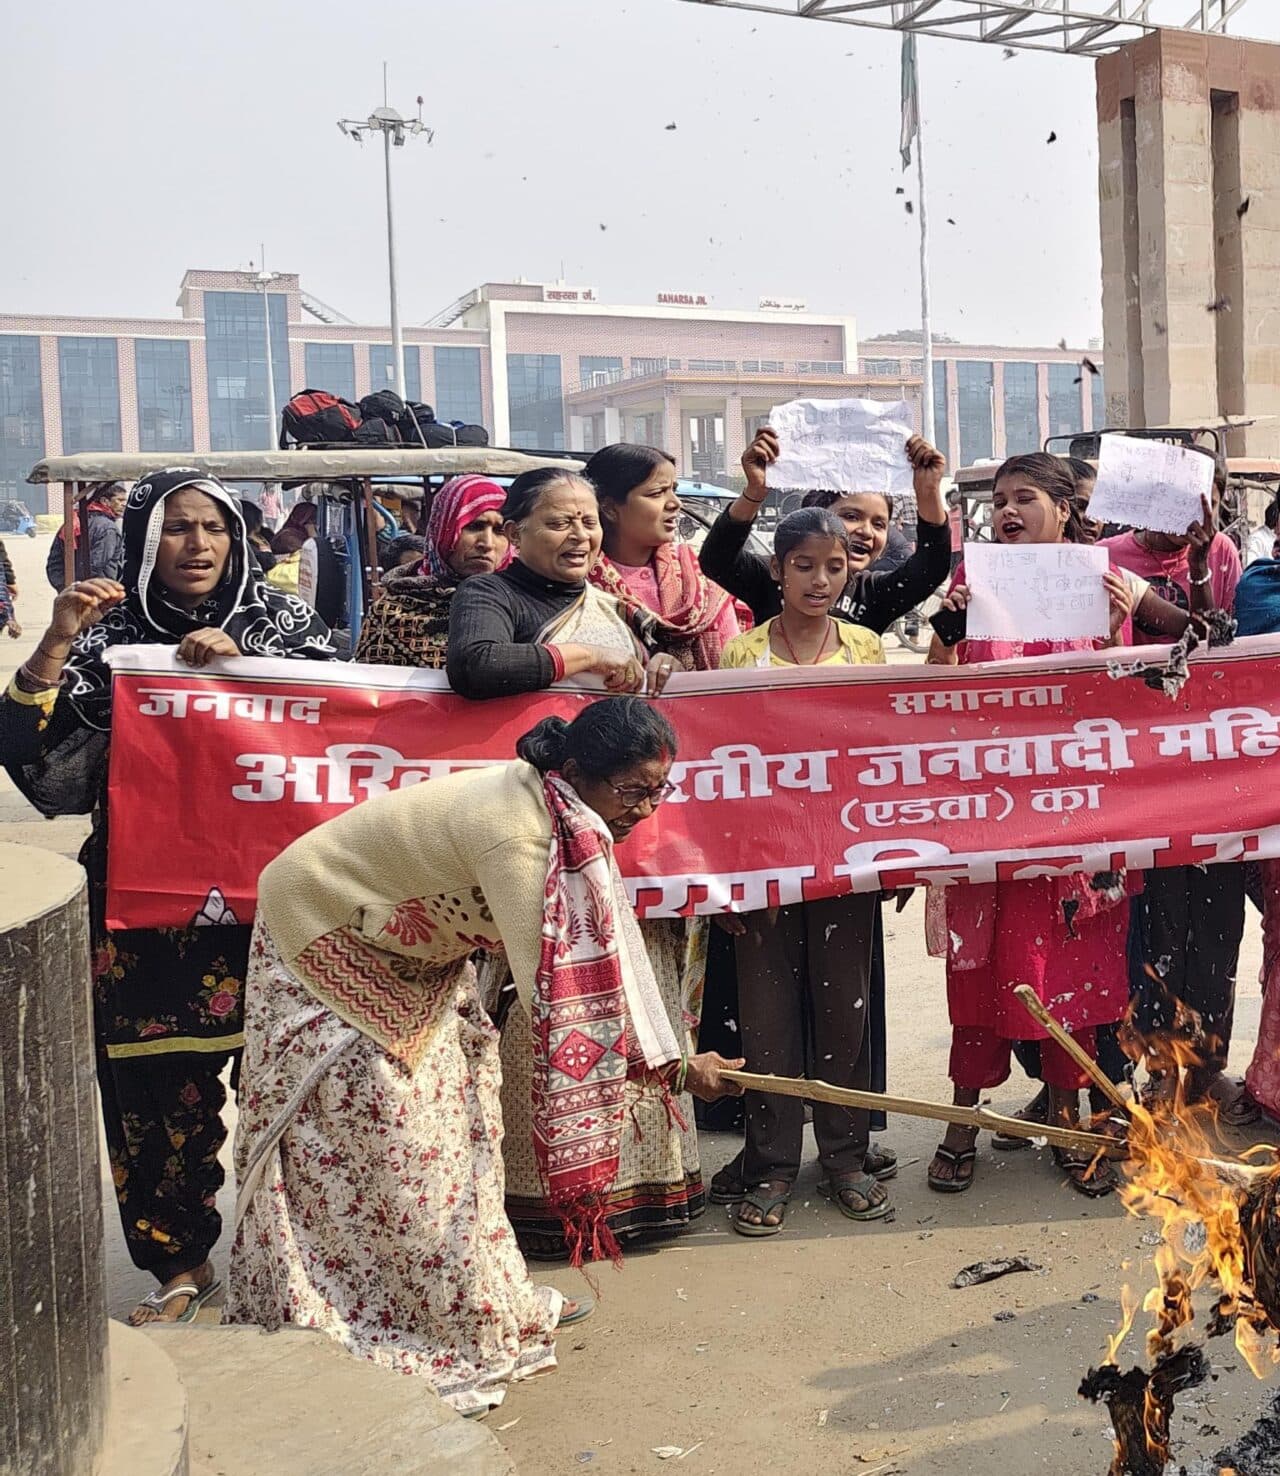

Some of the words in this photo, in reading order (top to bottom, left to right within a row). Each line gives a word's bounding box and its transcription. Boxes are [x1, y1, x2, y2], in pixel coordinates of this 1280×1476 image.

[657, 292, 694, 305] SAHARSA
[136, 687, 328, 725] जनवाद
[888, 684, 1068, 715] समानता
[848, 718, 1139, 787] जनवादी
[840, 786, 1014, 833] (एडवा)
[1030, 784, 1105, 814] का
